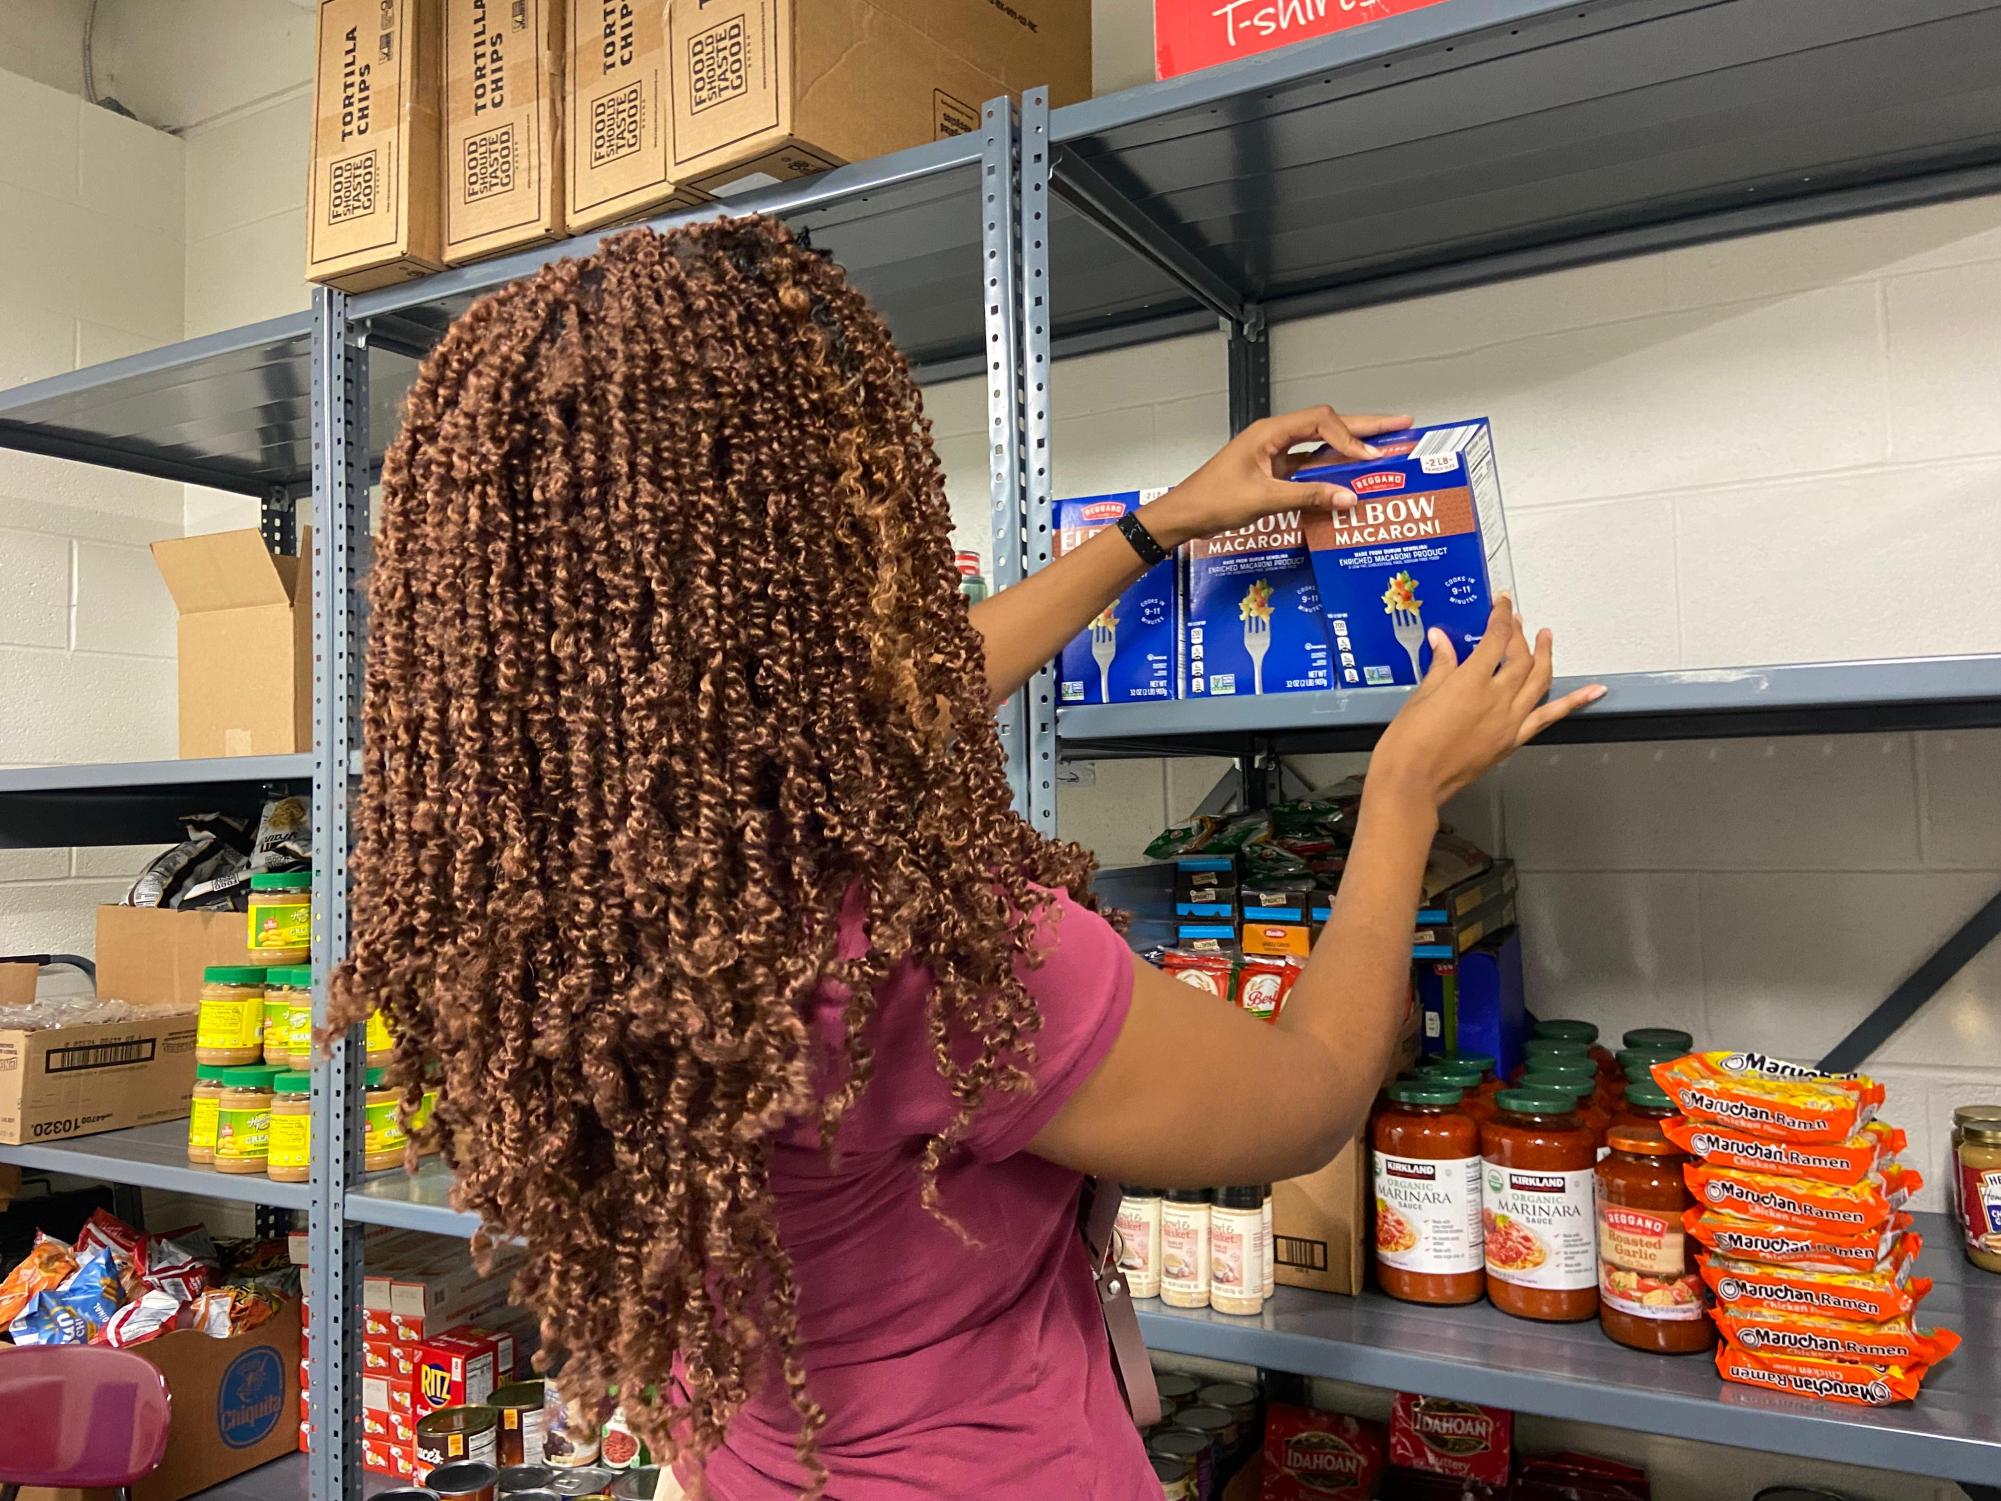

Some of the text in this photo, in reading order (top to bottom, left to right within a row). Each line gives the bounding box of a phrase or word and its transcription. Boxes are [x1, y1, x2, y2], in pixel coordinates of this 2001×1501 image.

[603, 0, 616, 75] TORTI
[620, 0, 633, 67] CHIP
[1212, 0, 1390, 46] T-shir
[474, 0, 487, 117] TORTILLA
[491, 32, 504, 109] CHIPS
[692, 39, 706, 107] FOOD
[705, 34, 717, 101] SHOULD
[717, 28, 730, 98] TASTE
[729, 23, 744, 91] GOOD
[341, 24, 358, 142] TORTILLA
[357, 63, 371, 136] CHIPS
[594, 102, 606, 162] FOOD
[606, 97, 616, 158] SHOULD
[615, 93, 627, 154] TASTE
[627, 89, 639, 148] GOOD
[467, 140, 479, 198] FOOD
[479, 137, 488, 194] SHOULD
[489, 133, 499, 192] TASTE
[499, 131, 511, 188] GOOD
[332, 165, 344, 219] FOOD
[343, 162, 353, 217] SHOULD
[352, 159, 363, 215] TASTE
[362, 156, 374, 211] GOOD
[1356, 474, 1401, 488] REGGANO
[1332, 495, 1435, 529] ELBOW
[1208, 531, 1302, 555] MACARONI
[1335, 519, 1441, 546] MACARONI
[1339, 555, 1373, 567] ENRICHED
[1375, 552, 1412, 563] MACARONI
[1413, 547, 1447, 559] PRODUCT
[1444, 576, 1466, 587] COOKS
[1451, 586, 1471, 595] 9-11
[1449, 594, 1478, 605] MINUTES
[1691, 1092, 1770, 1120] Maruchan
[1717, 1115, 1760, 1132] Chicken
[1387, 1160, 1434, 1175] KIRKLAND
[1706, 1135, 1851, 1170] Maruchan Ramen
[1733, 1157, 1776, 1171] Chicken
[1377, 1185, 1452, 1204] MARINARA
[1387, 1178, 1433, 1191] ORGANIC
[1511, 1175, 1564, 1188] KIRKLAND
[1512, 1192, 1564, 1205] ORGANIC
[1398, 1202, 1422, 1211] SAUCE
[1498, 1199, 1581, 1217] MARINARA
[1721, 1182, 1864, 1224] Maruchan Ramen
[1748, 1205, 1789, 1222] Chicken
[1526, 1216, 1552, 1225] SAUCE
[1608, 1230, 1662, 1250] Roasted
[1615, 1244, 1657, 1261] Garlic
[1728, 1234, 1811, 1254] Maruchan
[1735, 1280, 1879, 1315] Maruchan Ramen
[1762, 1301, 1808, 1313] Chicken
[75, 1318, 86, 1338] CHI
[1754, 1329, 1908, 1357] Maruchan Ramen
[421, 1364, 451, 1401] RITZ
[1730, 1366, 1877, 1402] Maruchan Ramen
[1798, 1365, 1843, 1380] Chicken
[222, 1393, 281, 1431] Chiquita
[1414, 1413, 1488, 1438] IDAHOAN
[1287, 1449, 1358, 1473] IDAHOAN
